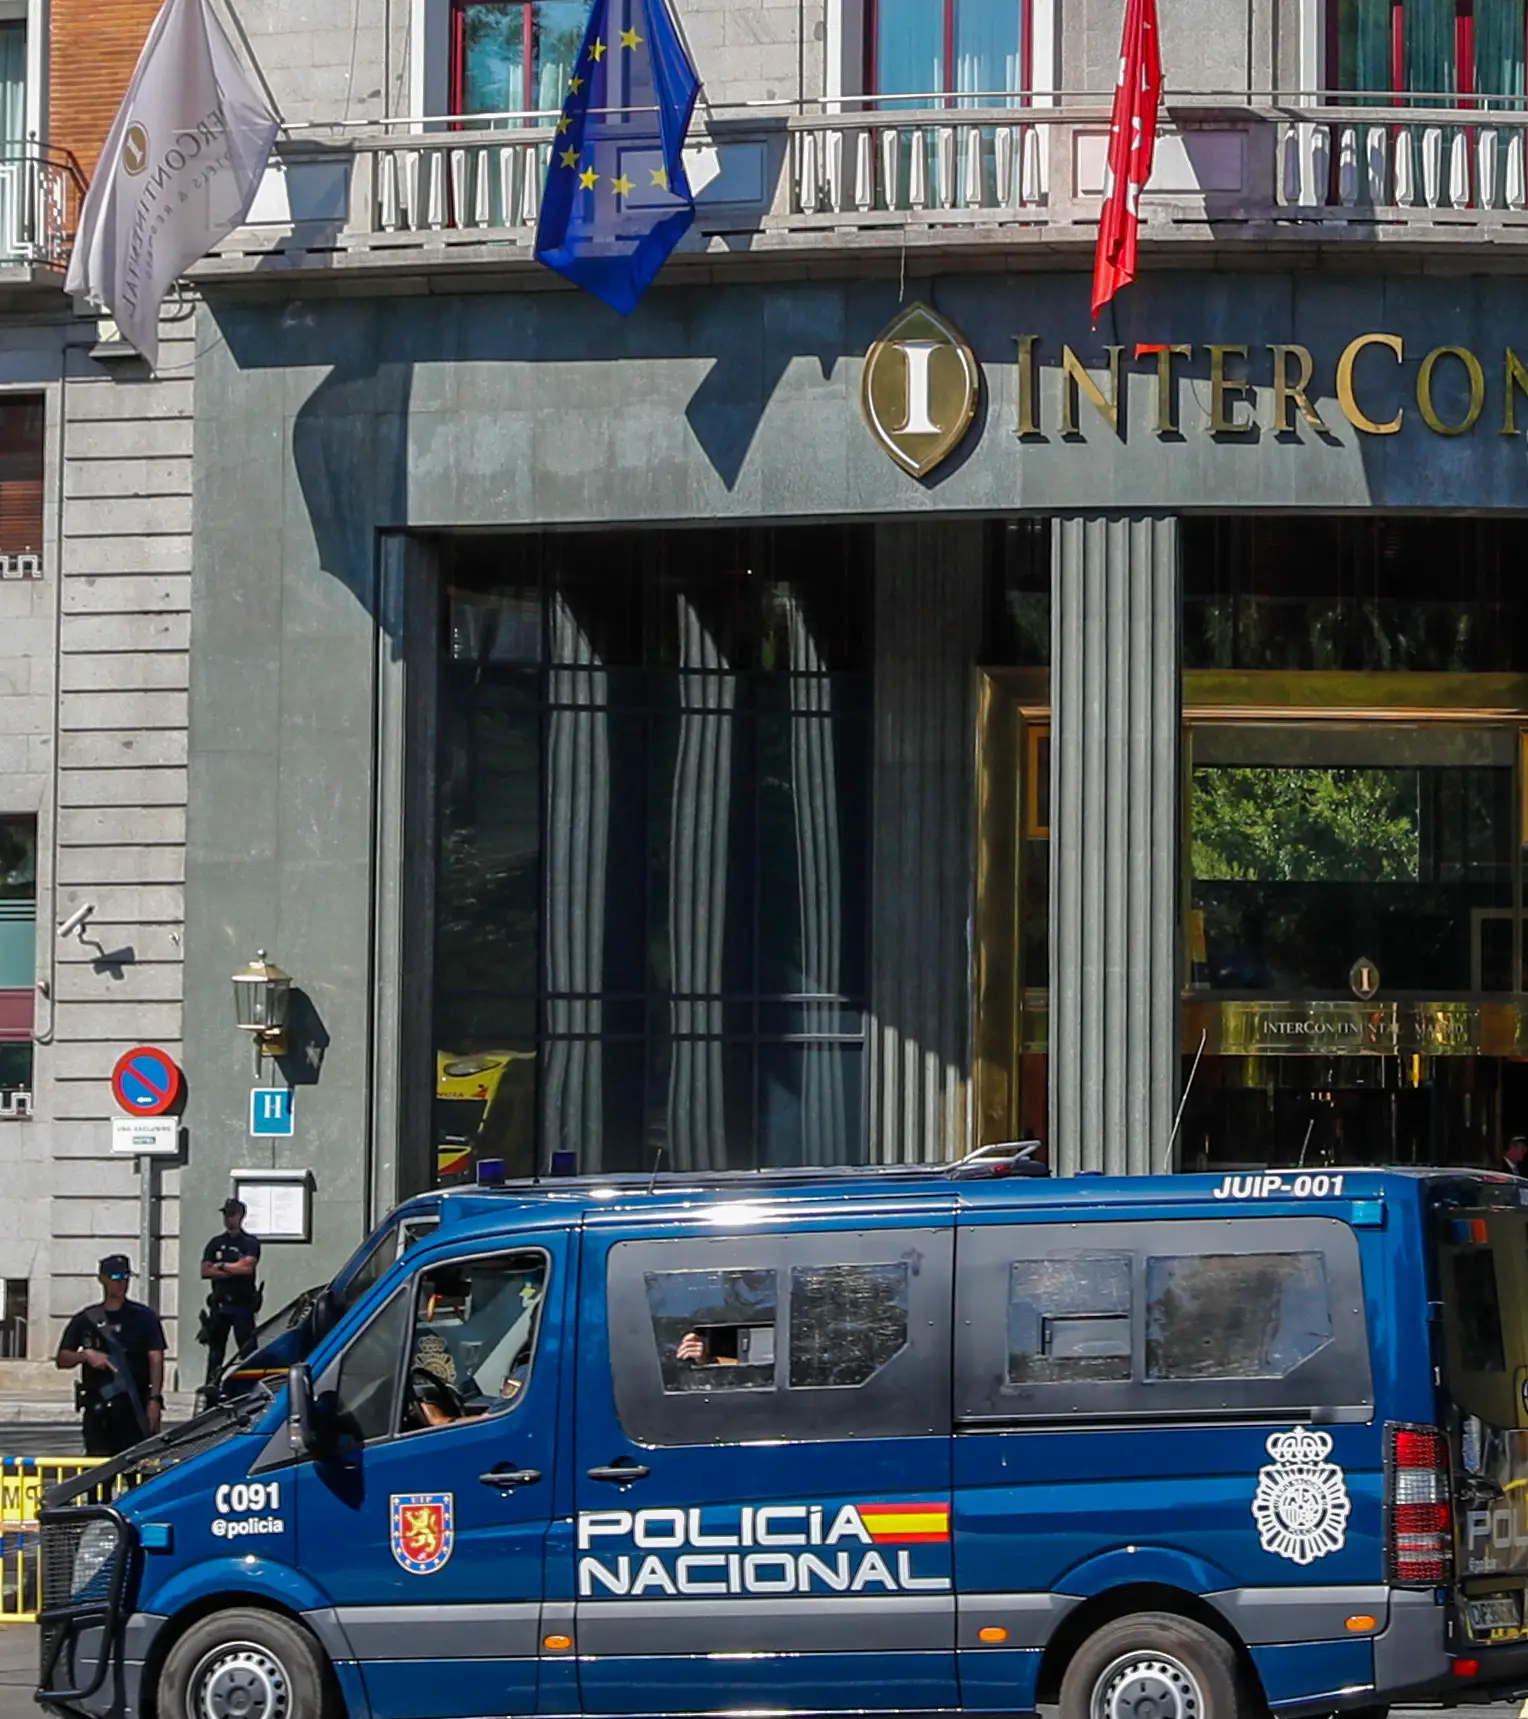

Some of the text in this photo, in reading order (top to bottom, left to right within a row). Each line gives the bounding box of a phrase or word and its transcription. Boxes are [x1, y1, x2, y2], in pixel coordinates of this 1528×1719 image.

[1213, 1175, 1344, 1199] JUIP-001
[211, 1515, 284, 1539] @policia
[577, 1550, 952, 1596] NACIONAL
